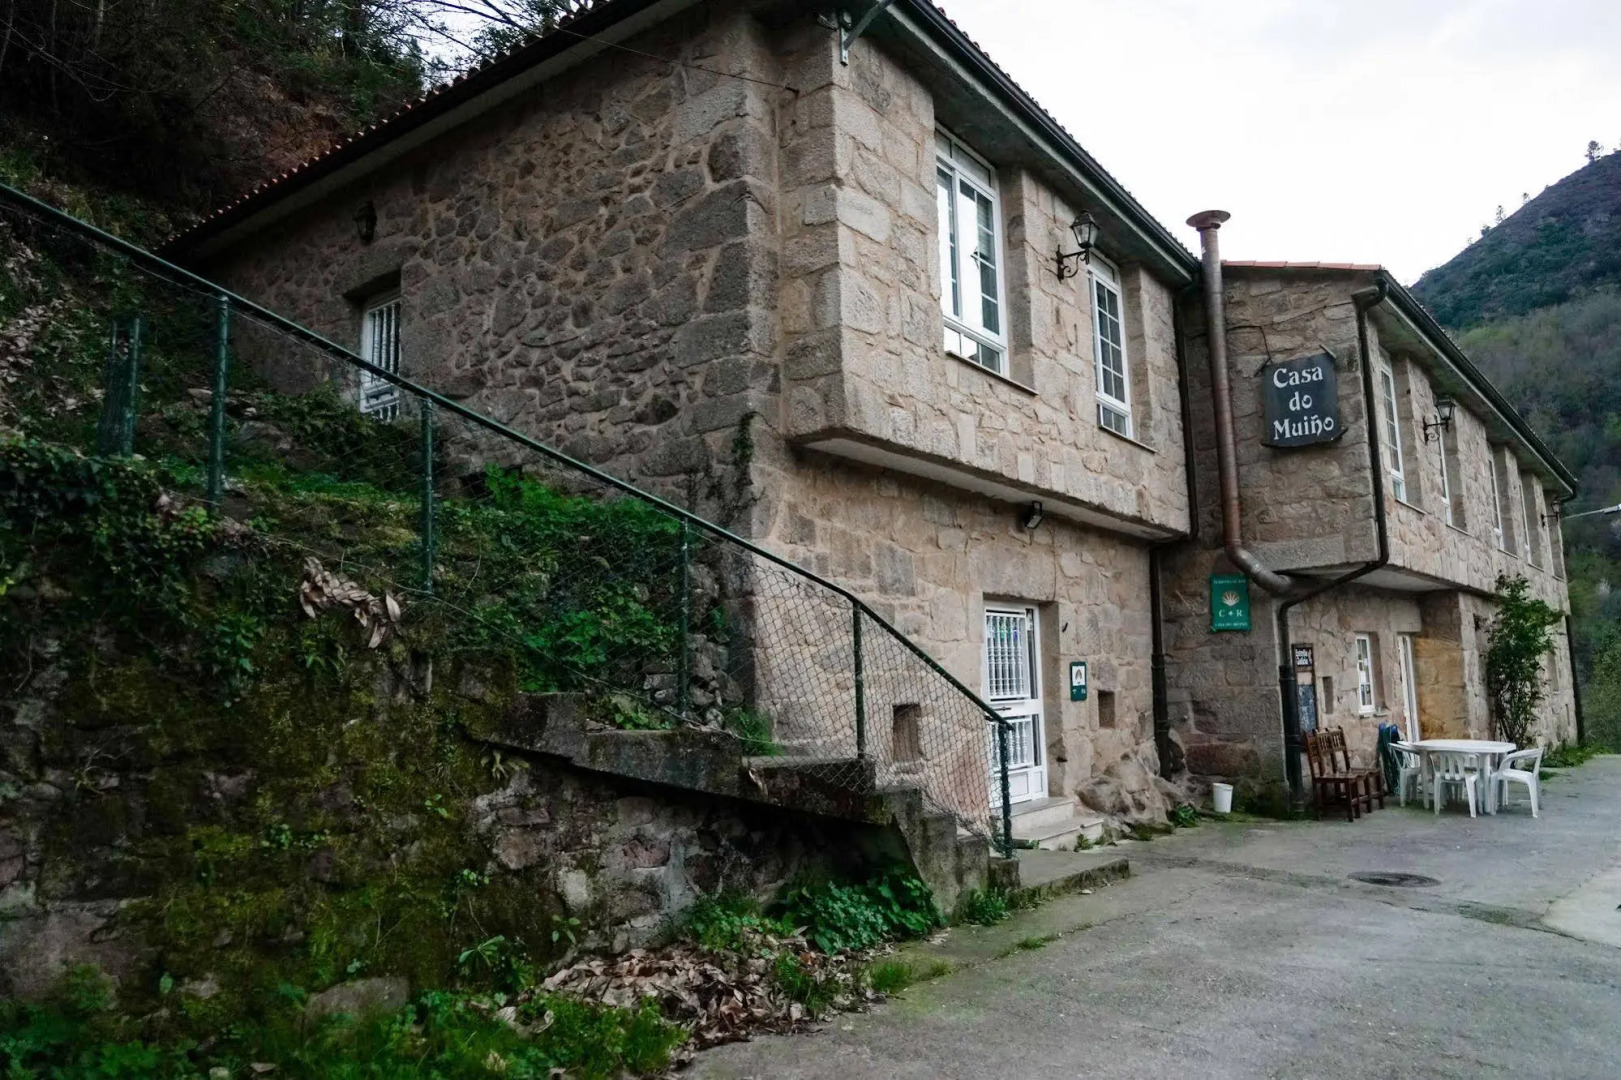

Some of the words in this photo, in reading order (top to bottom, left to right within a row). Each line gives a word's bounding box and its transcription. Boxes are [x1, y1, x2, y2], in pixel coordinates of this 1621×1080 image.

[1273, 366, 1324, 389] Casa
[1289, 391, 1313, 412] do
[1273, 414, 1334, 440] Muiño
[1218, 609, 1225, 618] C
[1236, 609, 1243, 618] R
